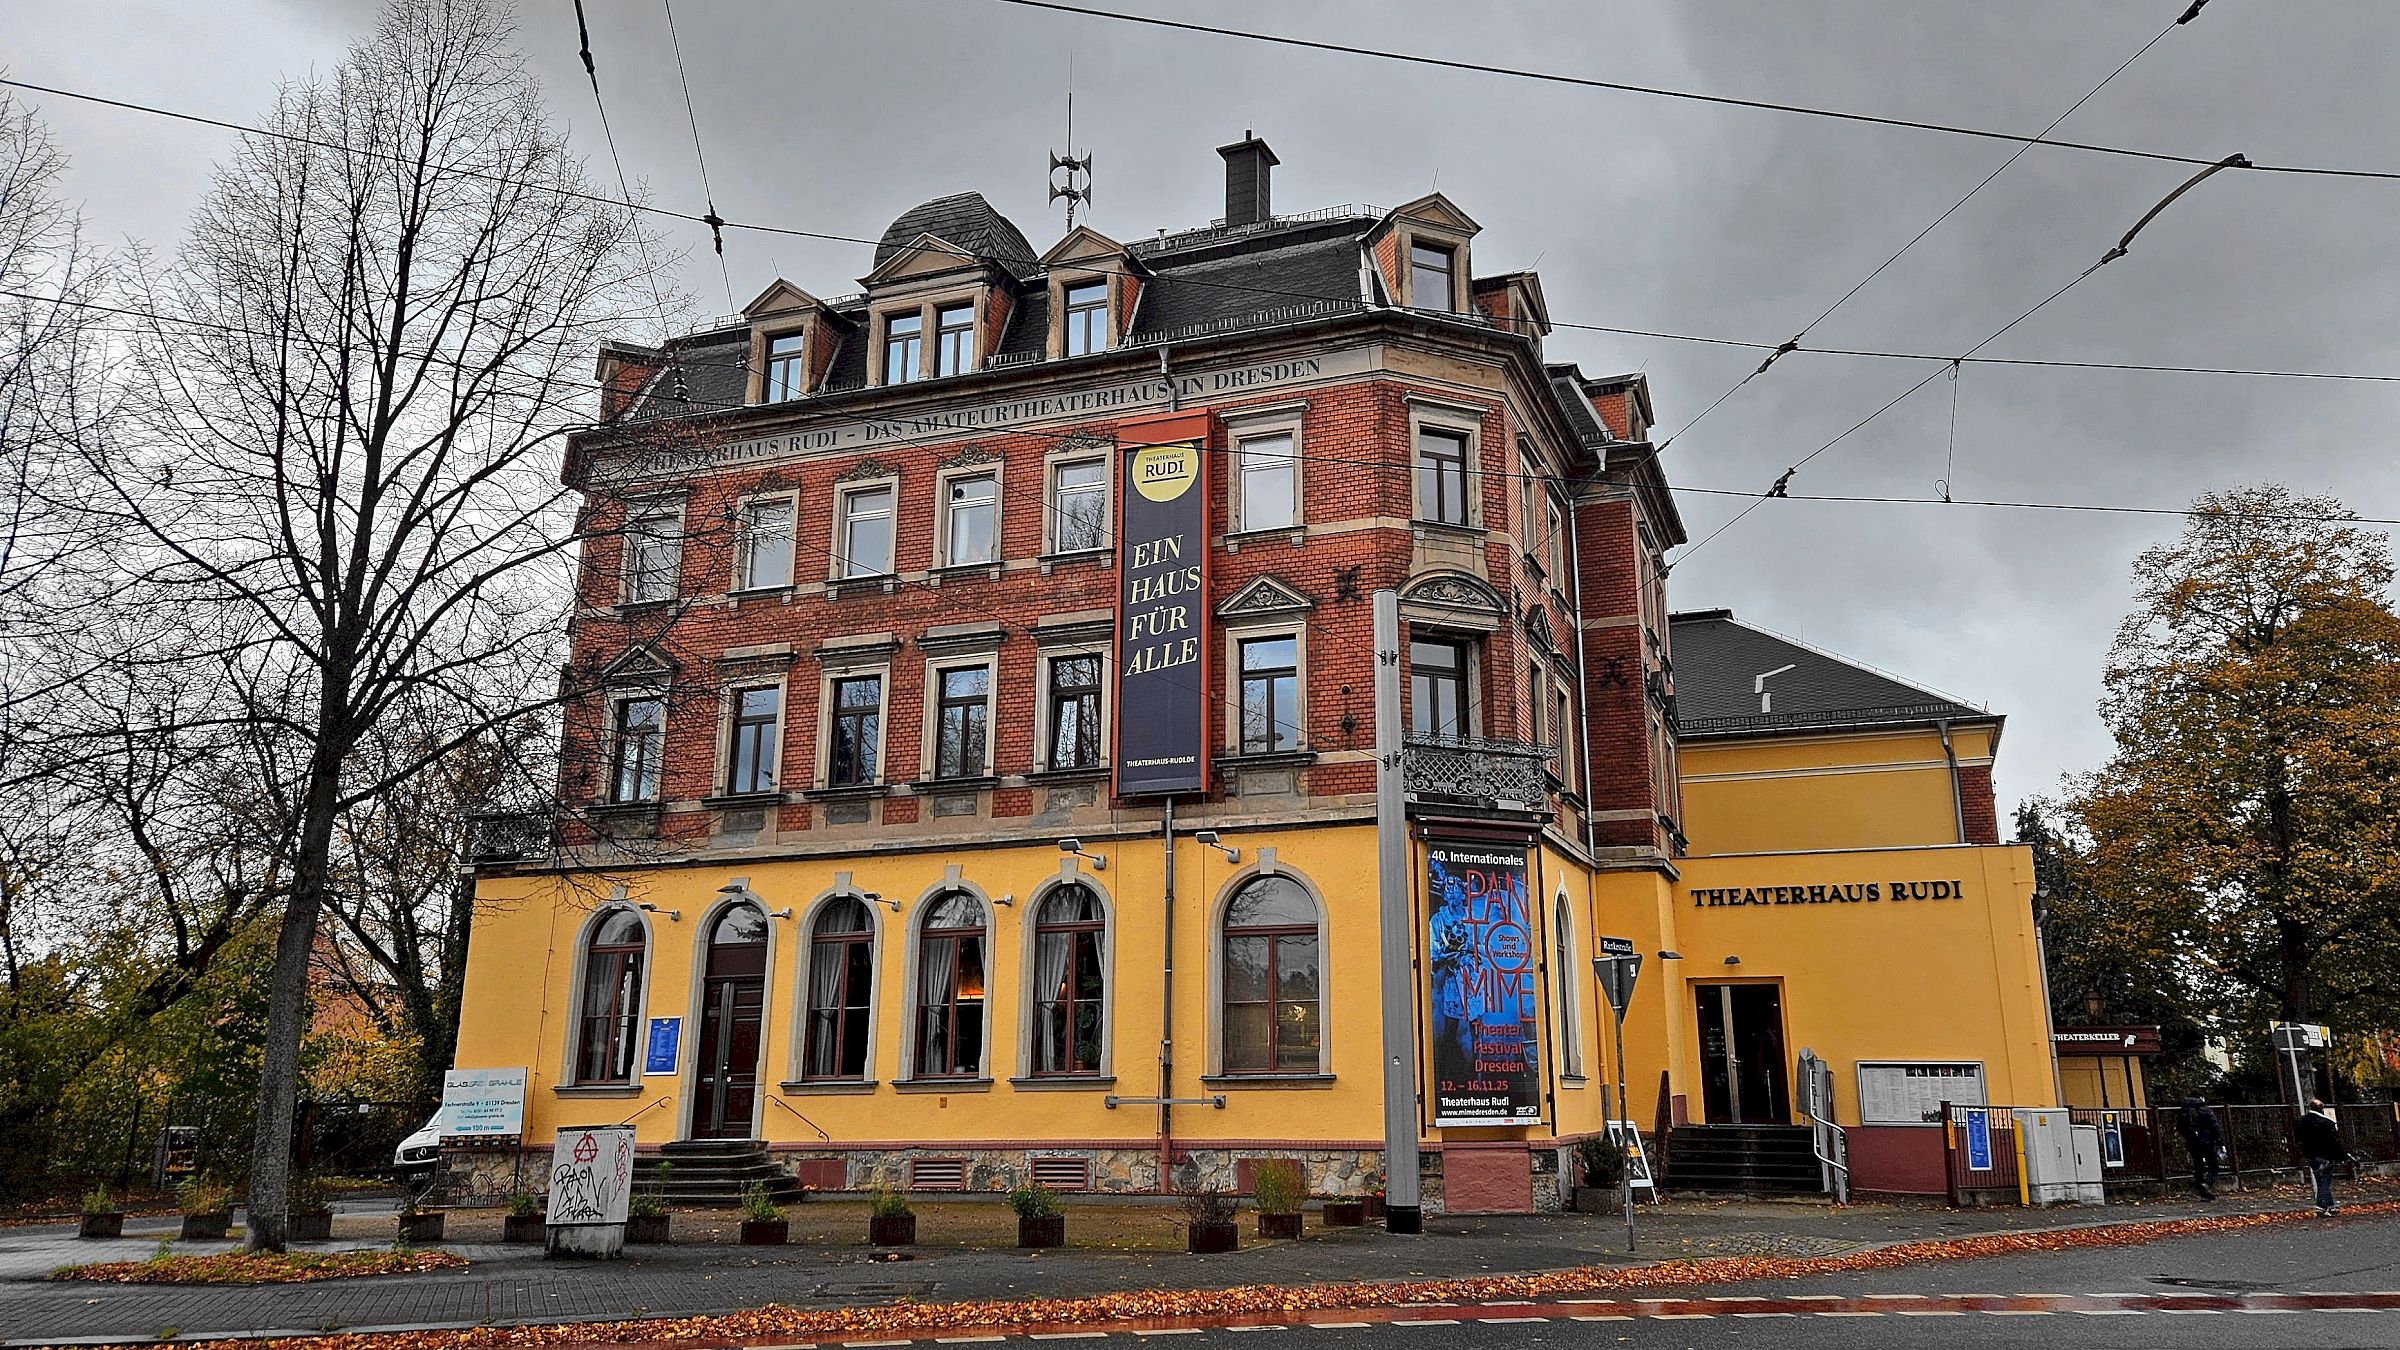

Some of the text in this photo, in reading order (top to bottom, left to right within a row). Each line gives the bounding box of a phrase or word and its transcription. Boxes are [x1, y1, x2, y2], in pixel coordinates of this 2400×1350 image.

[789, 430, 838, 451] RUDI
[866, 422, 902, 440] DAS
[910, 383, 1168, 434] AMATEURTHEATERHAUS
[1181, 376, 1204, 395] IN
[1213, 359, 1321, 390] DRESDEN
[1146, 453, 1184, 462] THEATERHAUS
[1146, 460, 1184, 477] RUDI
[1131, 534, 1183, 569] EIN
[1130, 565, 1200, 605] HAUS
[1128, 606, 1188, 641] FÜR
[1125, 638, 1198, 676] ALLE
[1126, 756, 1195, 767] THEATERHAUS-RUDI.DE
[1432, 850, 1524, 866] 40. Internationales
[1466, 869, 1529, 923] PAN
[1691, 880, 1963, 907] THEATERHAUS RUDI
[1498, 934, 1520, 942] Shows
[1462, 968, 1536, 1022] MIME
[1473, 1022, 1521, 1036] Theater
[2054, 1033, 2120, 1041] THEATERKELLER
[1474, 1041, 1522, 1055] Festival
[1475, 1060, 1524, 1072] Dresden
[1441, 1081, 1456, 1091] 12.
[1468, 1081, 1508, 1092] 16.11.25
[1441, 1096, 1509, 1106] Theaterhaus Rudi
[1441, 1108, 1508, 1116] www.mimedresden.de
